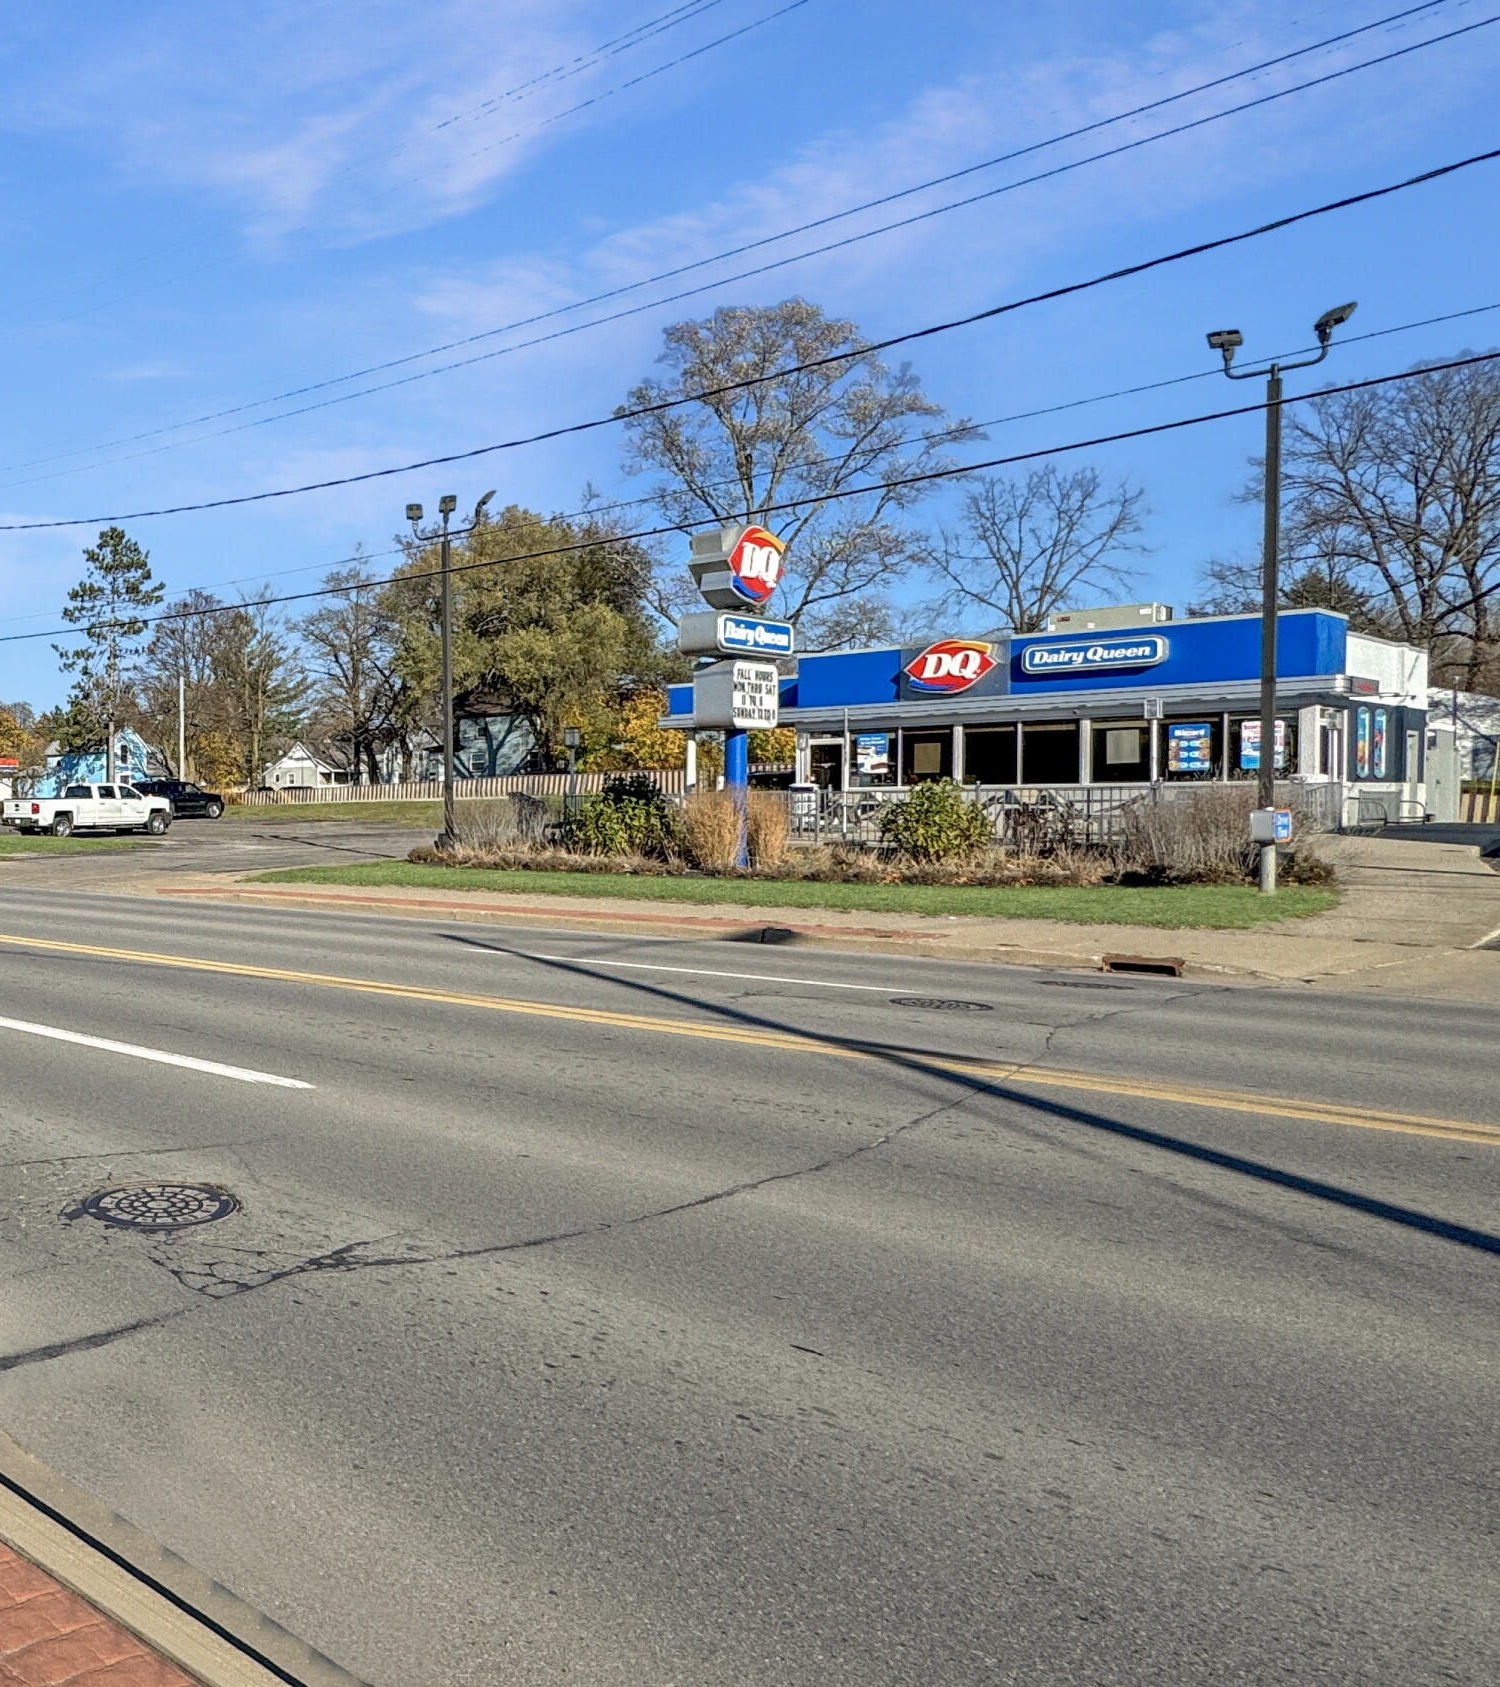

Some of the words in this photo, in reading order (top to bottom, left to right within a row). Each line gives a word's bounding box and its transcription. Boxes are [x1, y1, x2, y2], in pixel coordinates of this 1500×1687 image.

[740, 541, 780, 588] DQ
[724, 620, 755, 646] Dairy
[755, 626, 789, 647] Queen
[921, 651, 981, 679] DQ
[1032, 650, 1083, 665] Dairy
[1086, 646, 1152, 662] Queen
[737, 668, 751, 680] FALL
[755, 670, 774, 682] HOURS
[765, 684, 776, 695] SAT
